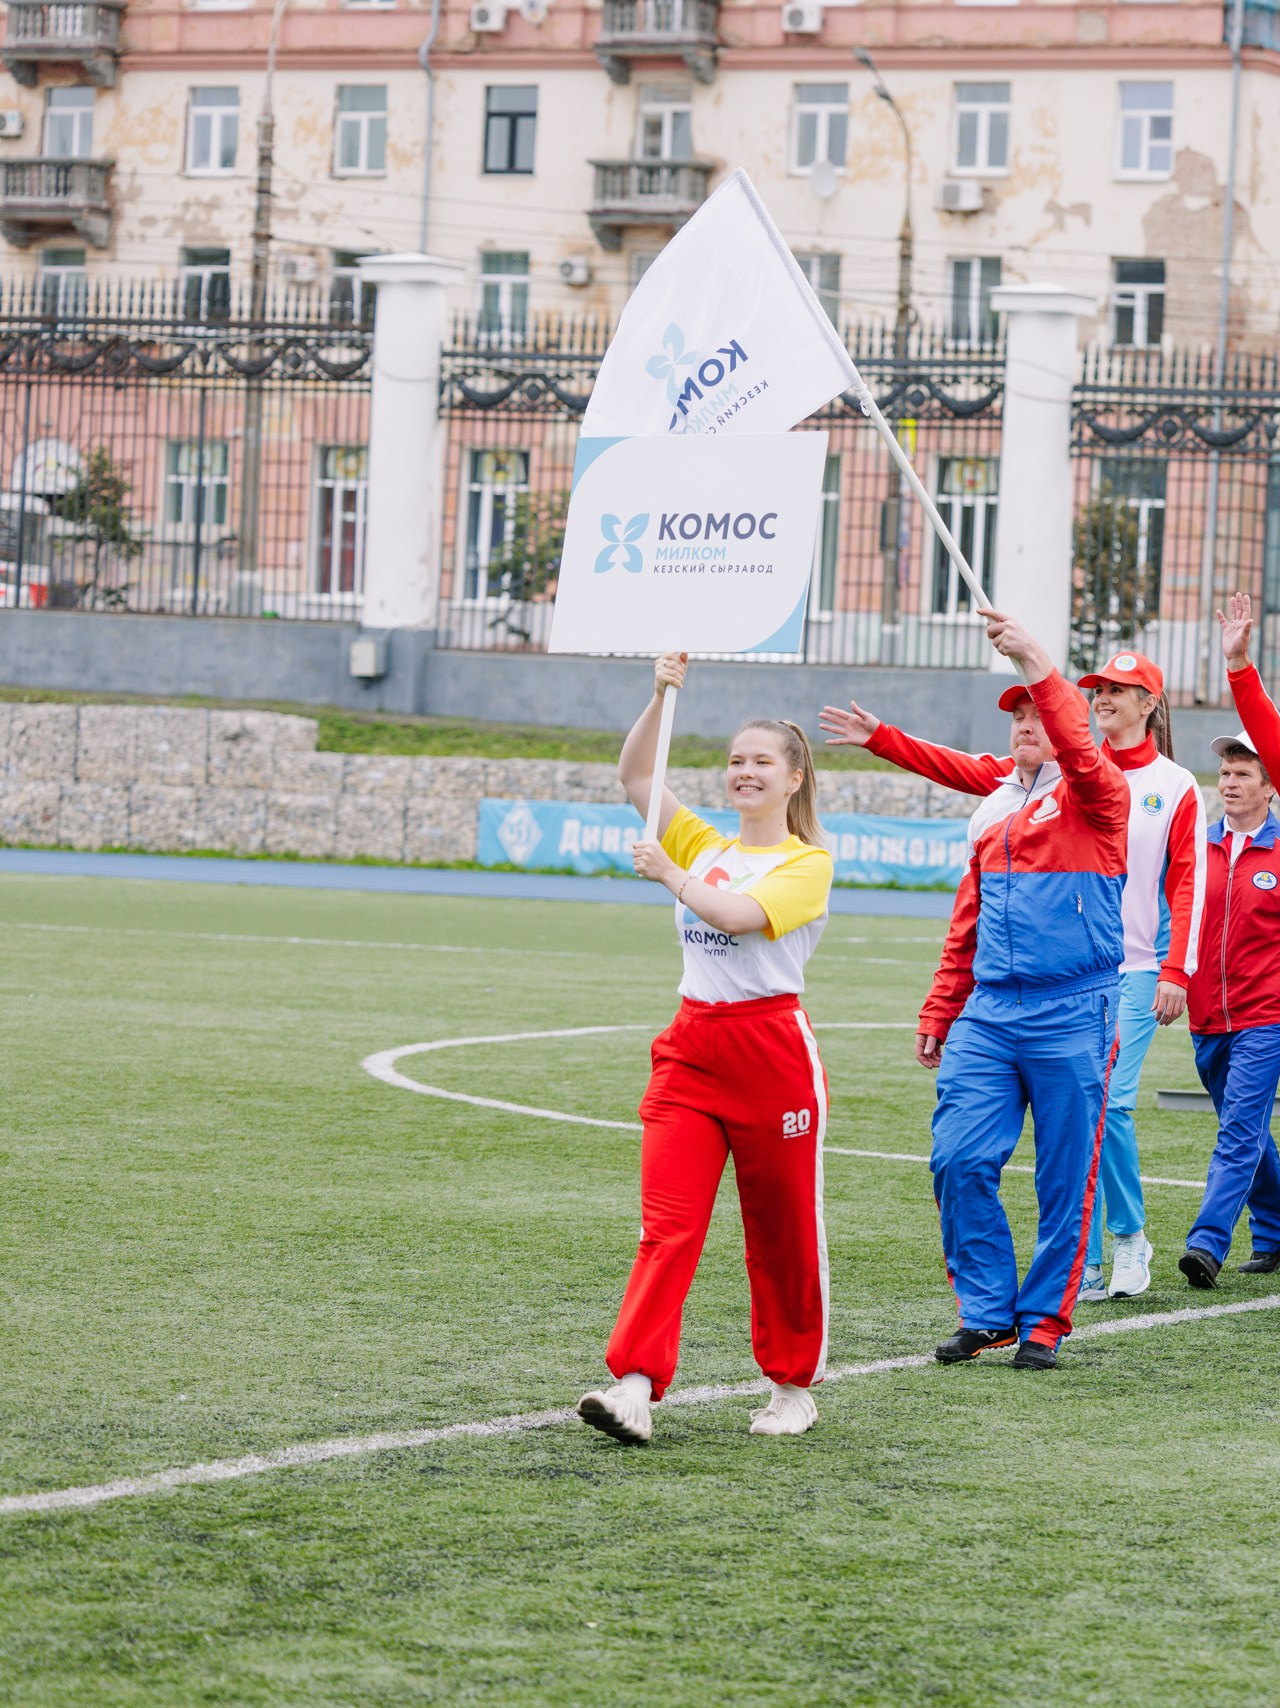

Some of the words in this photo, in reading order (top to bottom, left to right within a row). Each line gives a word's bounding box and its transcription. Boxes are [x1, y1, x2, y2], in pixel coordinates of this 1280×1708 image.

[658, 512, 778, 541] КОМОС
[655, 547, 727, 561] МИЛКОМ
[653, 563, 706, 574] КЕЗСКИЙ
[710, 564, 774, 574] СЫРЗАВОД
[559, 818, 646, 856] Дина
[684, 929, 739, 946] КОМОС
[782, 1108, 811, 1135] 20
